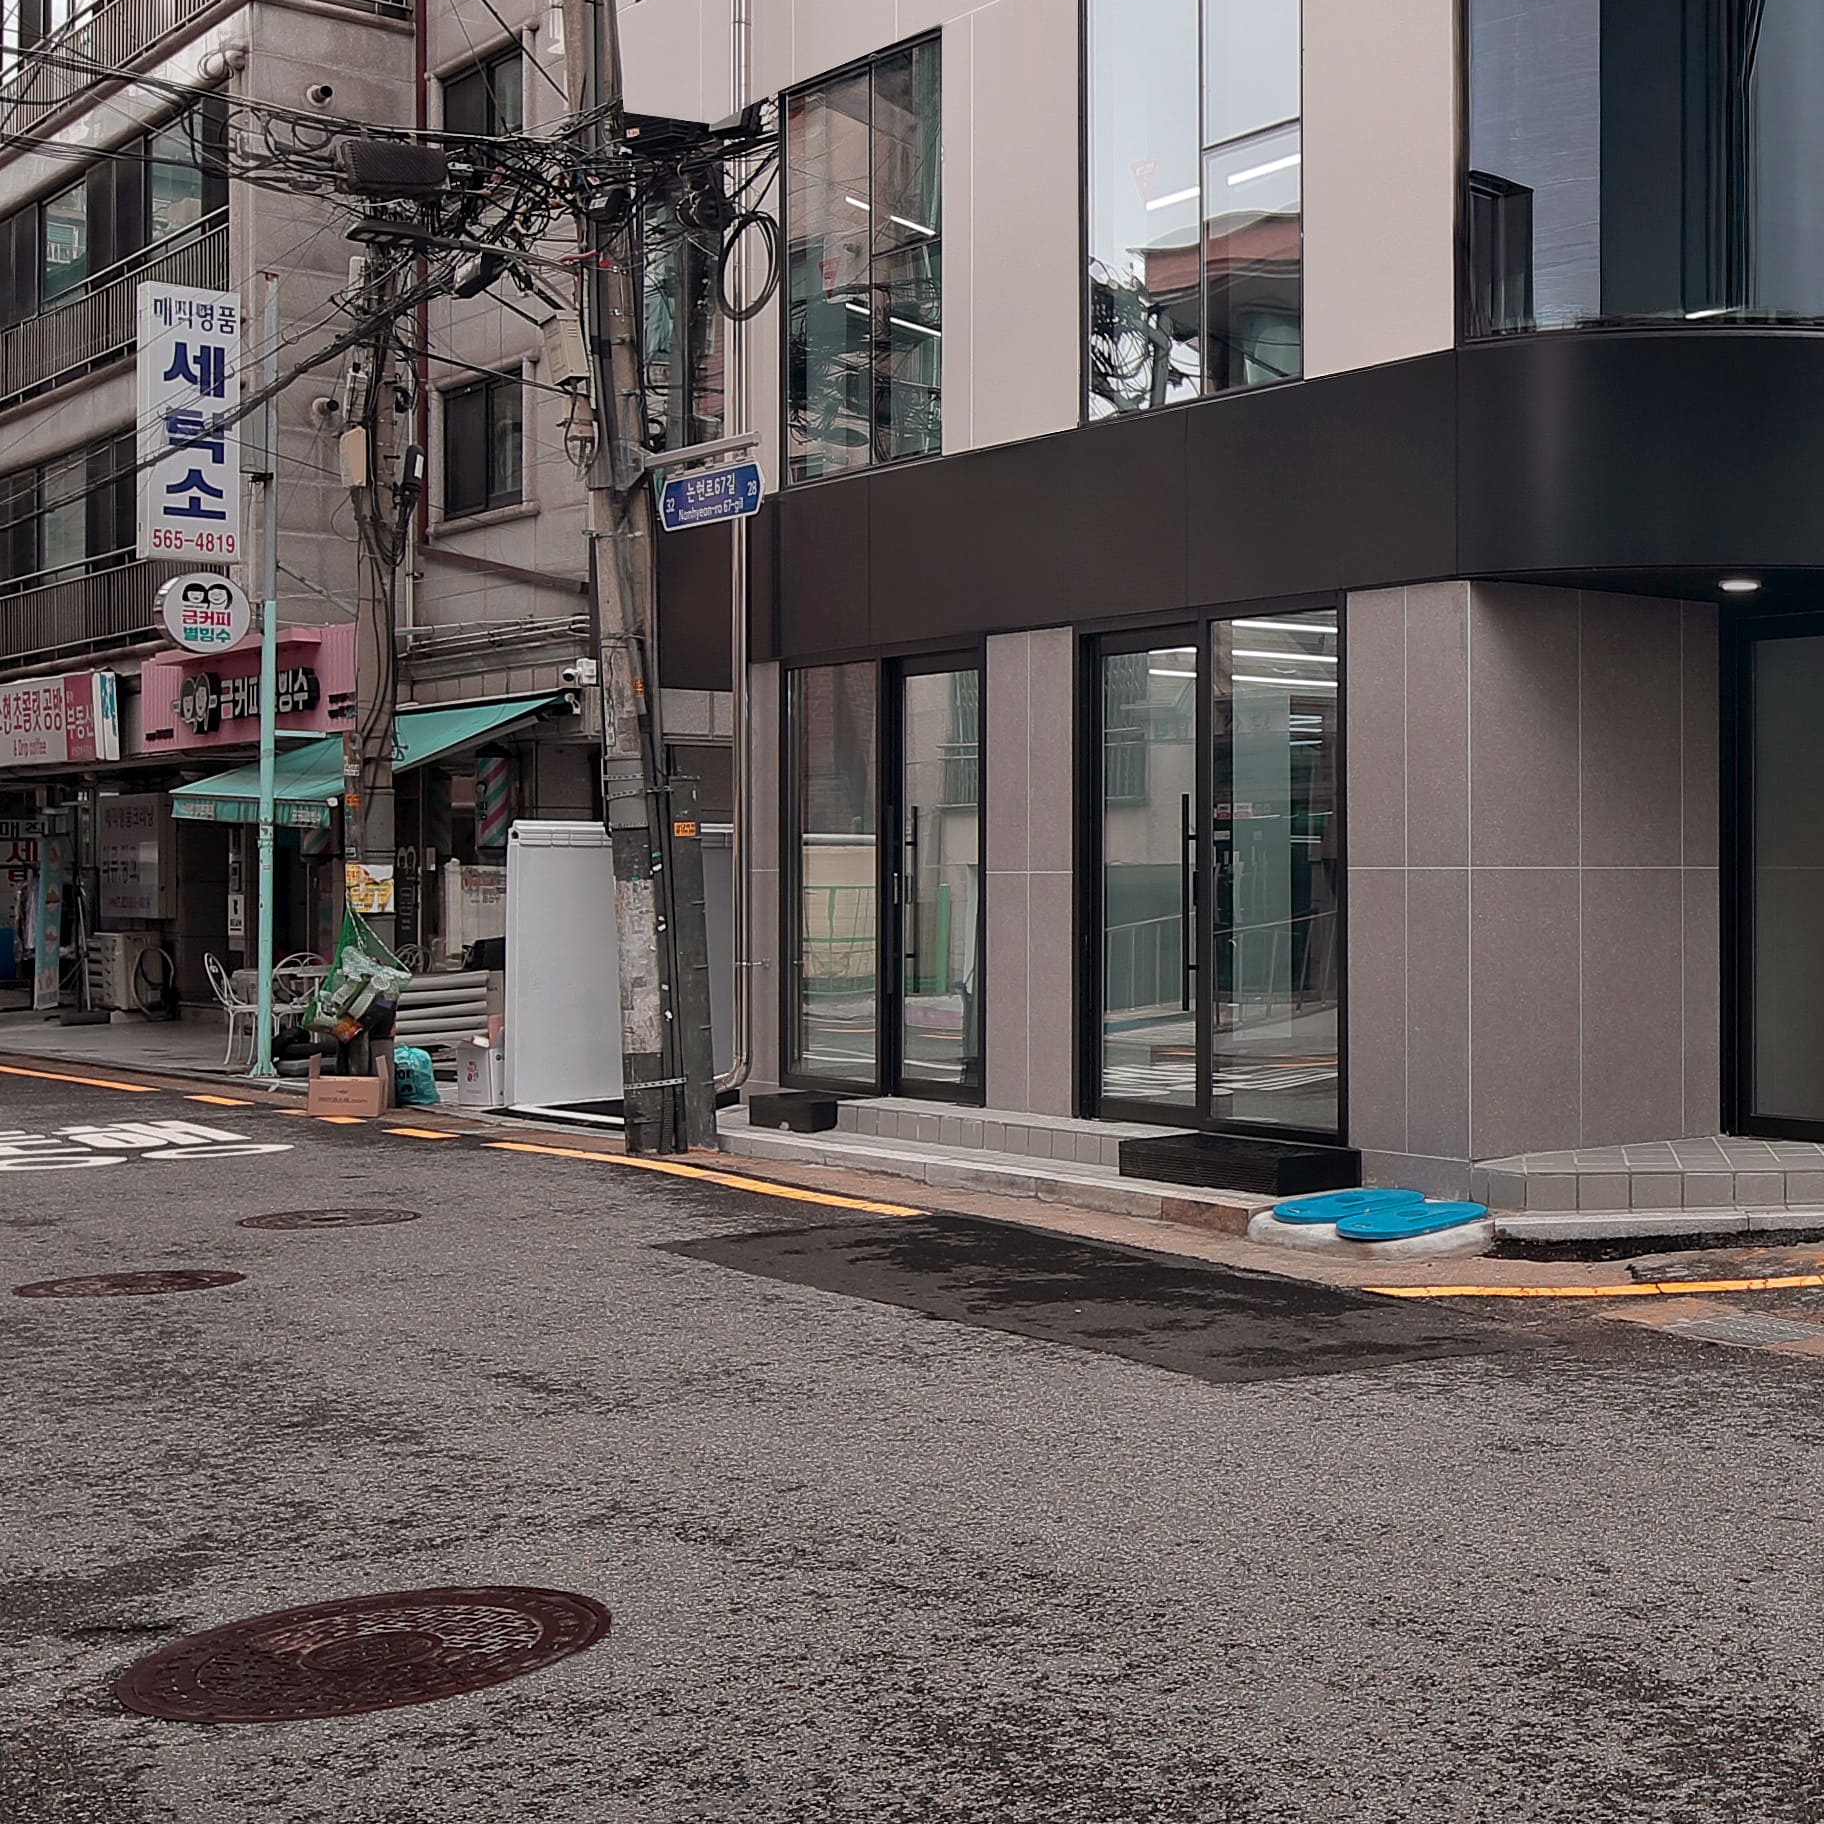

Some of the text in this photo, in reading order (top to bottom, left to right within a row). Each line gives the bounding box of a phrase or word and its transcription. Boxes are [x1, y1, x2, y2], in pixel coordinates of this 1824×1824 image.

[163, 341, 232, 521] 세탁소
[686, 472, 735, 503] 논현로67길
[666, 497, 675, 513] 32
[153, 528, 235, 553] 565-4819
[182, 609, 231, 627] 금커피
[66, 705, 94, 740] 부동산
